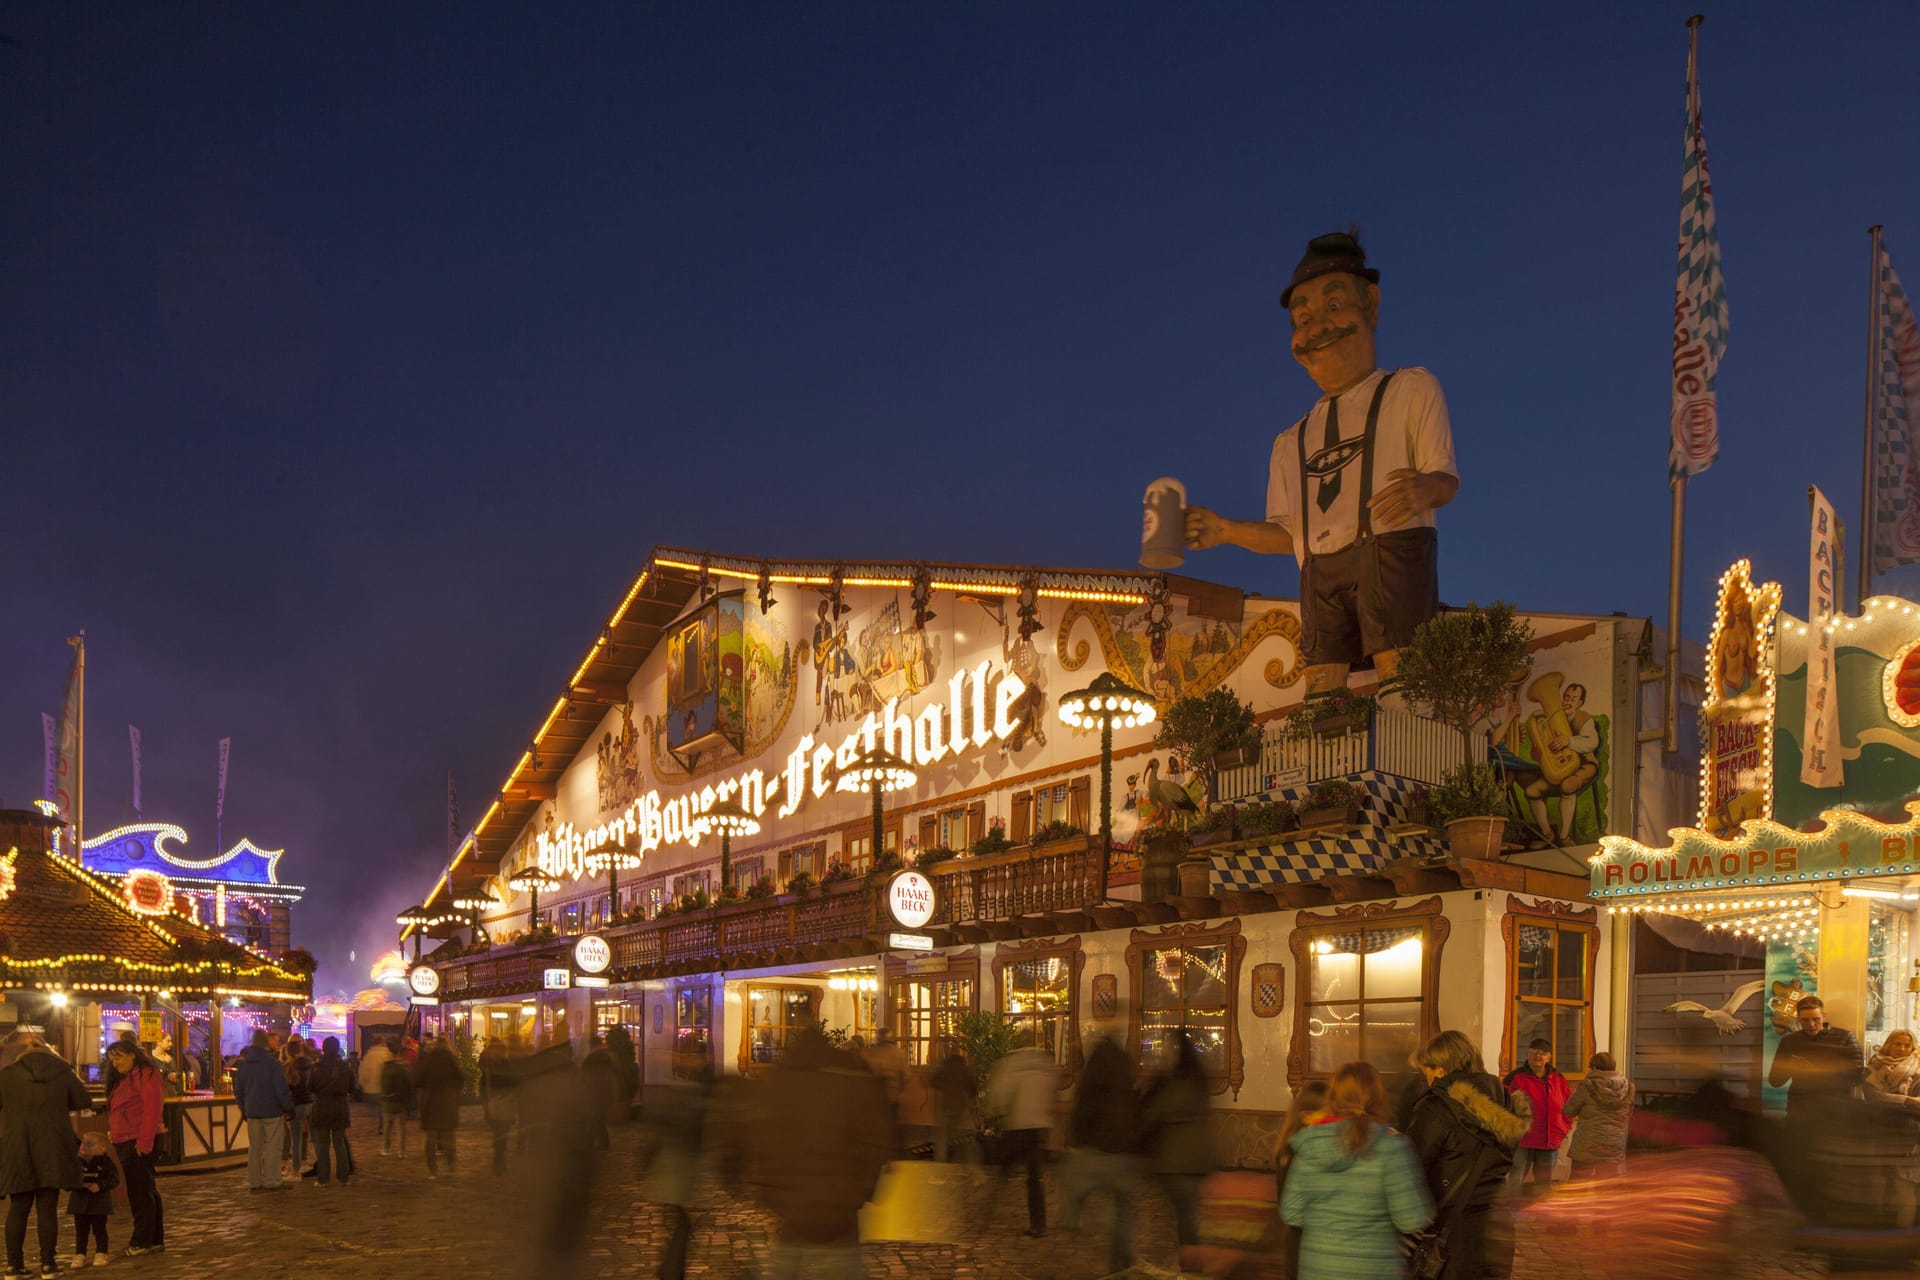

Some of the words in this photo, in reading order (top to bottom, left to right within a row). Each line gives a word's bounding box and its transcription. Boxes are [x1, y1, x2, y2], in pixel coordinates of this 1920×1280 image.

[1605, 847, 1798, 887] ROLLMOPS
[897, 887, 929, 901] HAAKE
[901, 900, 925, 912] BECK
